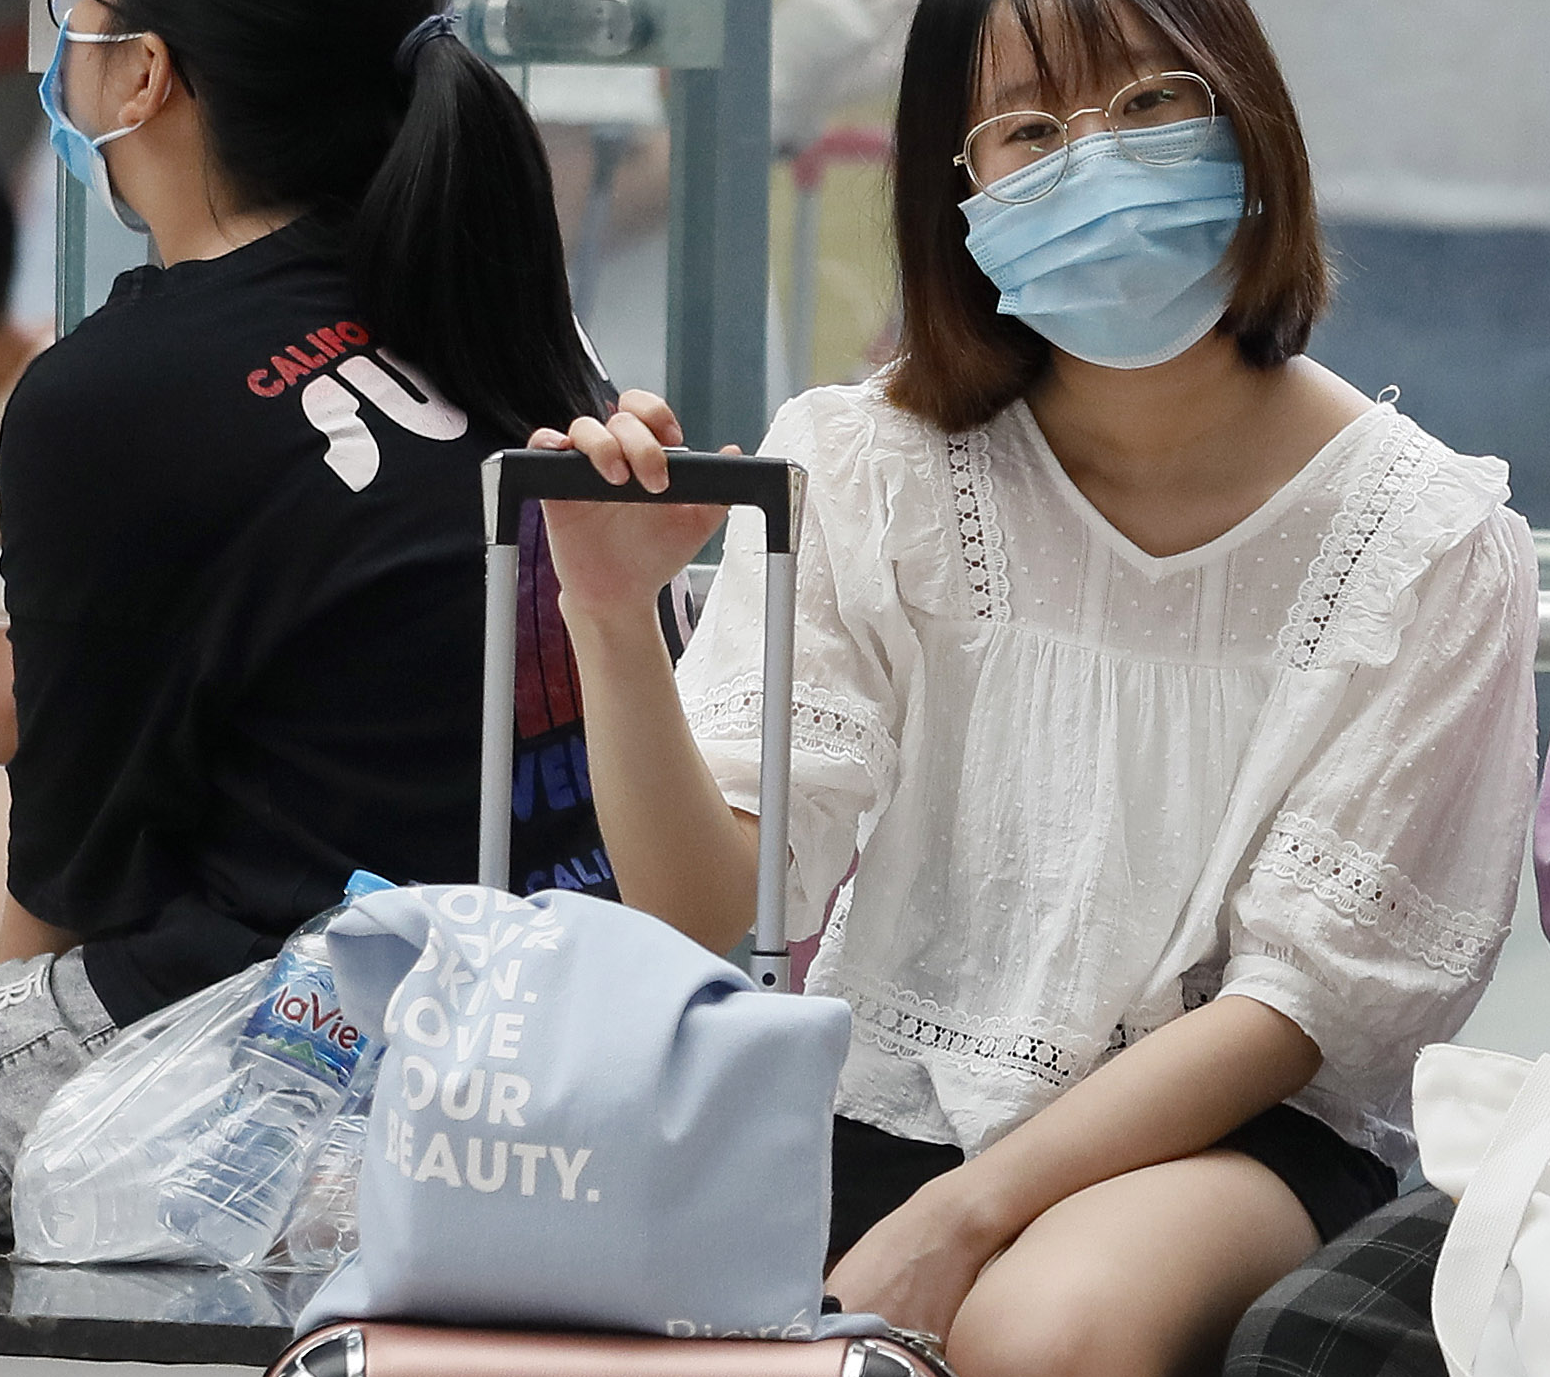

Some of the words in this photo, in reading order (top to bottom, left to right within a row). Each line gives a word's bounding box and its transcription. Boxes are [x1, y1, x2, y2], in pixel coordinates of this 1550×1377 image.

[246, 321, 369, 398] CALIFO
[526, 847, 612, 894] CALI
[273, 986, 360, 1050] laVie
[401, 1055, 532, 1127] OUR
[385, 1108, 600, 1203] BEAUTY.
